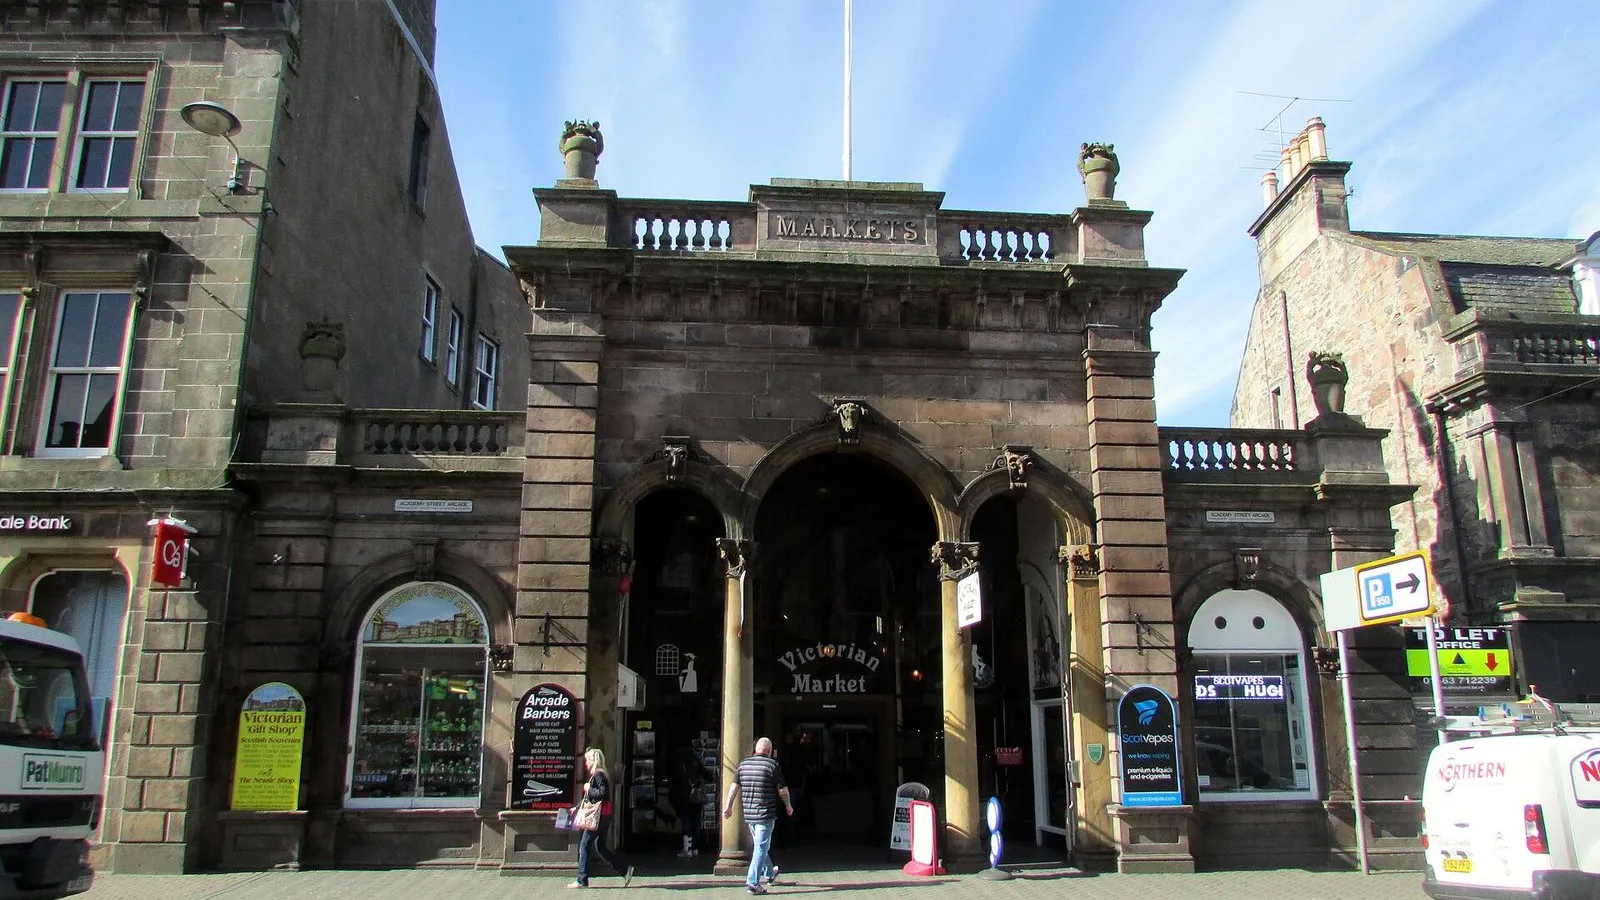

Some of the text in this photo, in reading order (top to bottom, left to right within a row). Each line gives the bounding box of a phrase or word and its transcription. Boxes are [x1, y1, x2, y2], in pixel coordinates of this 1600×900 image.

[776, 214, 919, 241] MARKETS
[0, 515, 71, 529] ale Bank
[1368, 578, 1383, 607] P
[1375, 595, 1390, 605] 950
[1454, 628, 1498, 640] LET
[1436, 641, 1480, 650] OFFICE
[778, 642, 880, 671] Victorian
[791, 674, 866, 693] Market
[1213, 677, 1264, 685] SCOTVAPES
[1458, 676, 1497, 685] 712239
[525, 693, 569, 706] Arcade
[244, 711, 302, 724] Victorian
[523, 706, 570, 719] Barbers
[26, 760, 83, 783] PatMunro
[1127, 766, 1173, 775] premium e-liquids
[1438, 762, 1506, 783] NORTHERN
